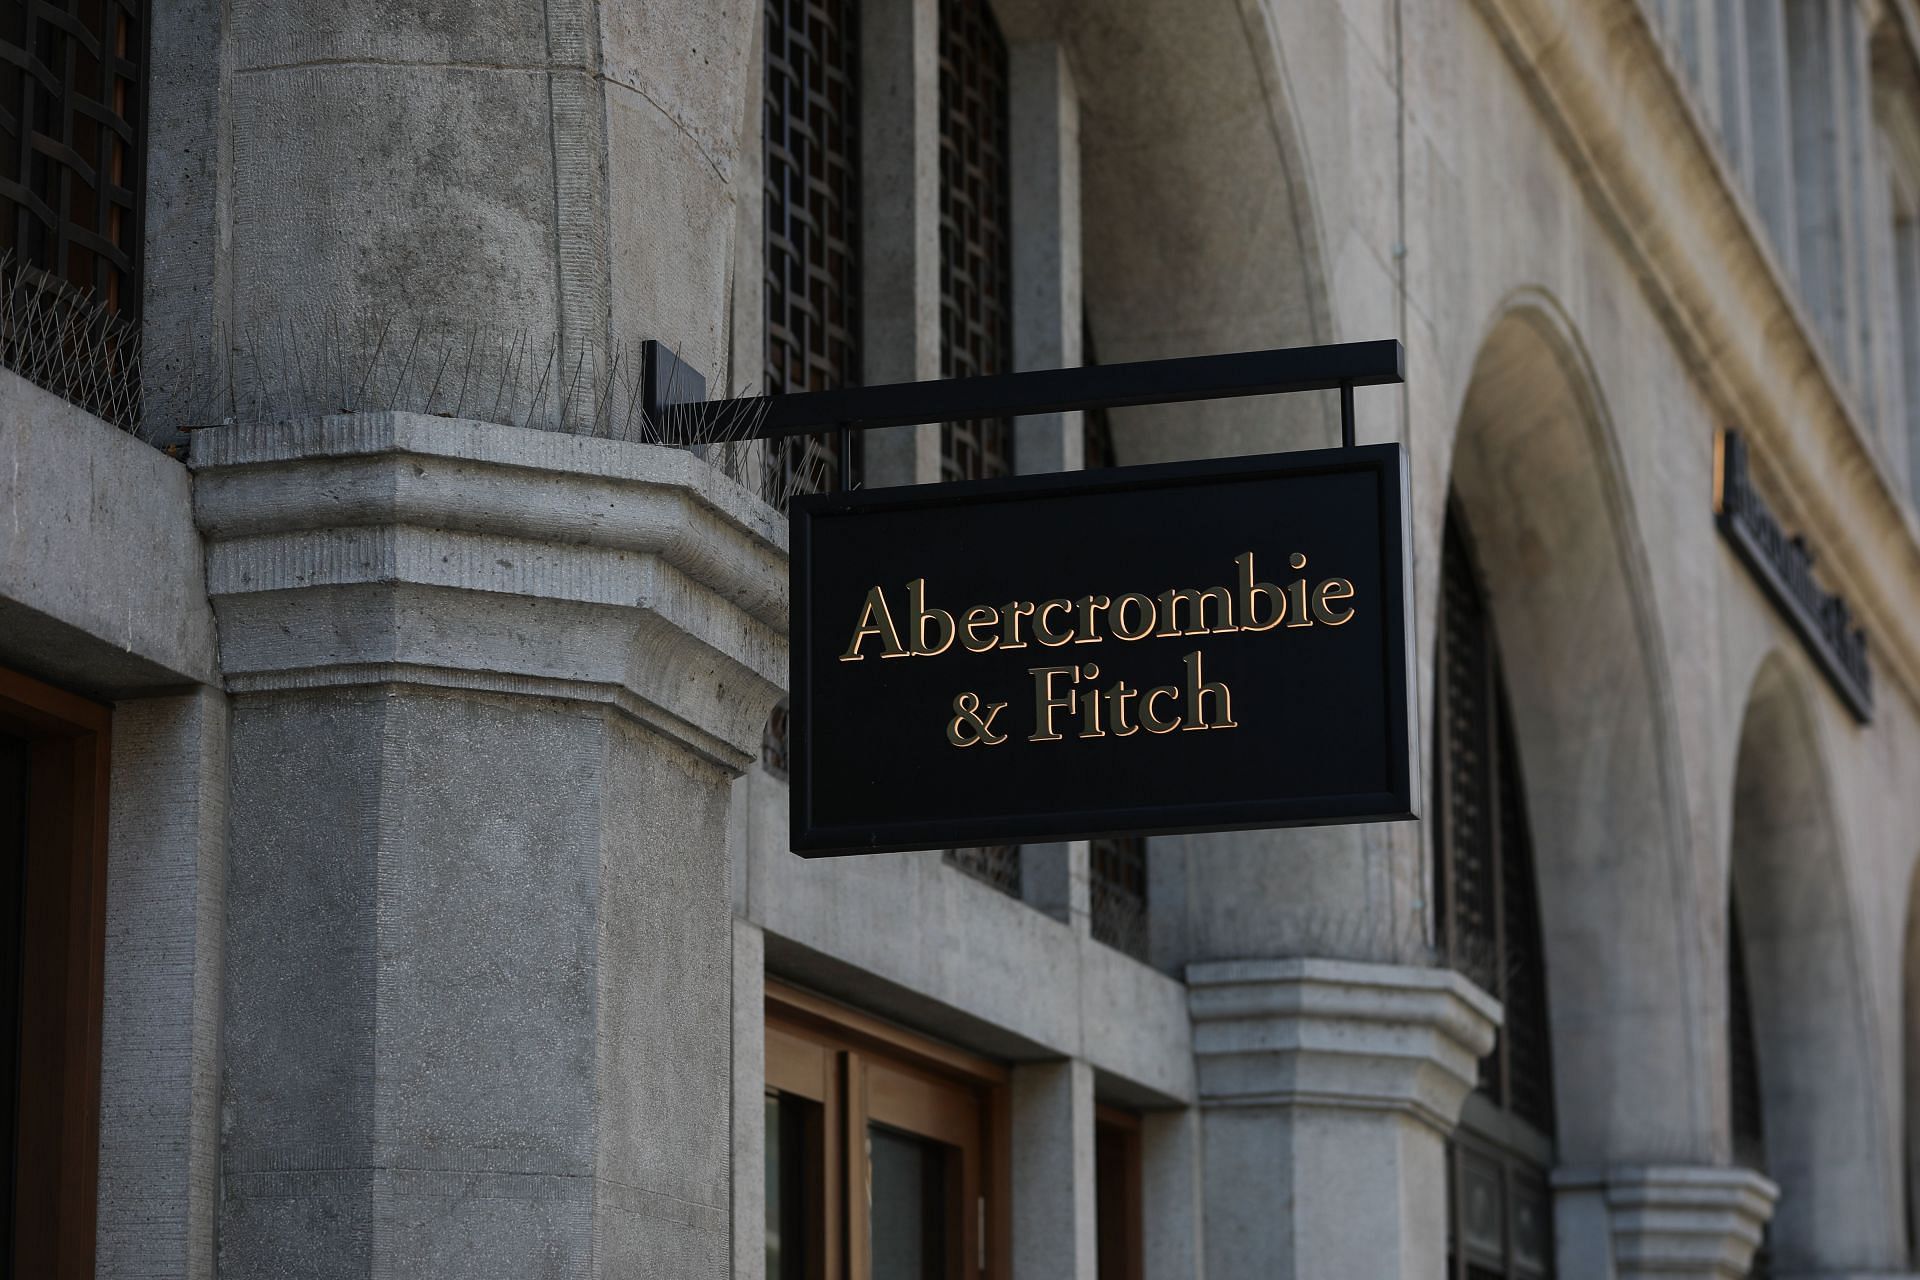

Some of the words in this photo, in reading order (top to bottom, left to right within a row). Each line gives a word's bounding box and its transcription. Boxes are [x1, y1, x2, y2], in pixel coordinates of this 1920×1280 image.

[838, 551, 1355, 662] Abercrombie
[946, 691, 1008, 749] &
[1027, 650, 1238, 743] Fitch
